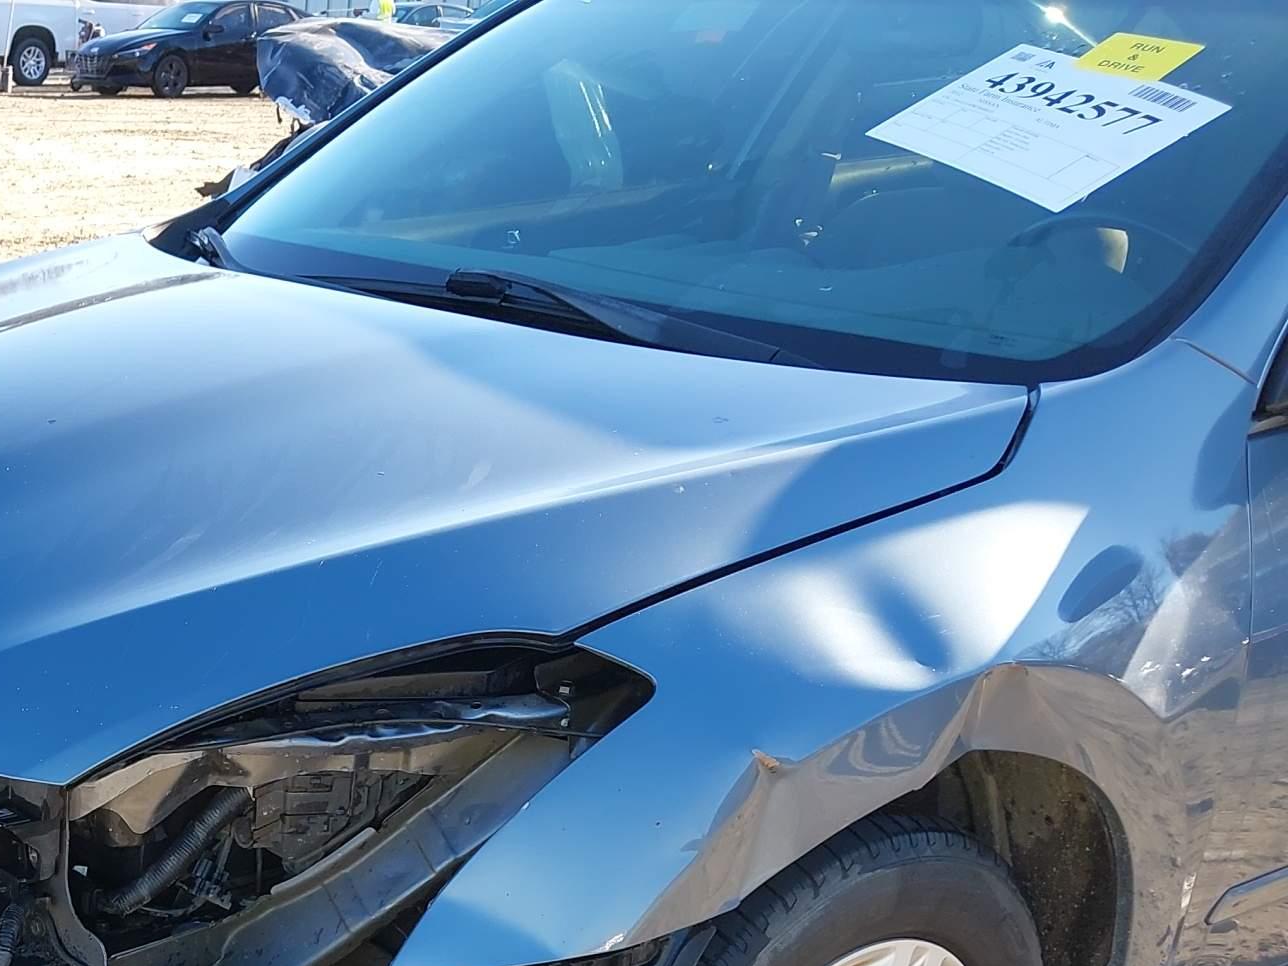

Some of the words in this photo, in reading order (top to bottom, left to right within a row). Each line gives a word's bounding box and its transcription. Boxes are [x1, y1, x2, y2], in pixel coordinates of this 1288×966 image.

[1130, 42, 1166, 54] RUN
[1128, 53, 1140, 62] &
[1097, 59, 1145, 73] DRIVE
[985, 72, 1163, 135] 43942577
[1001, 95, 1041, 113] Insurance
